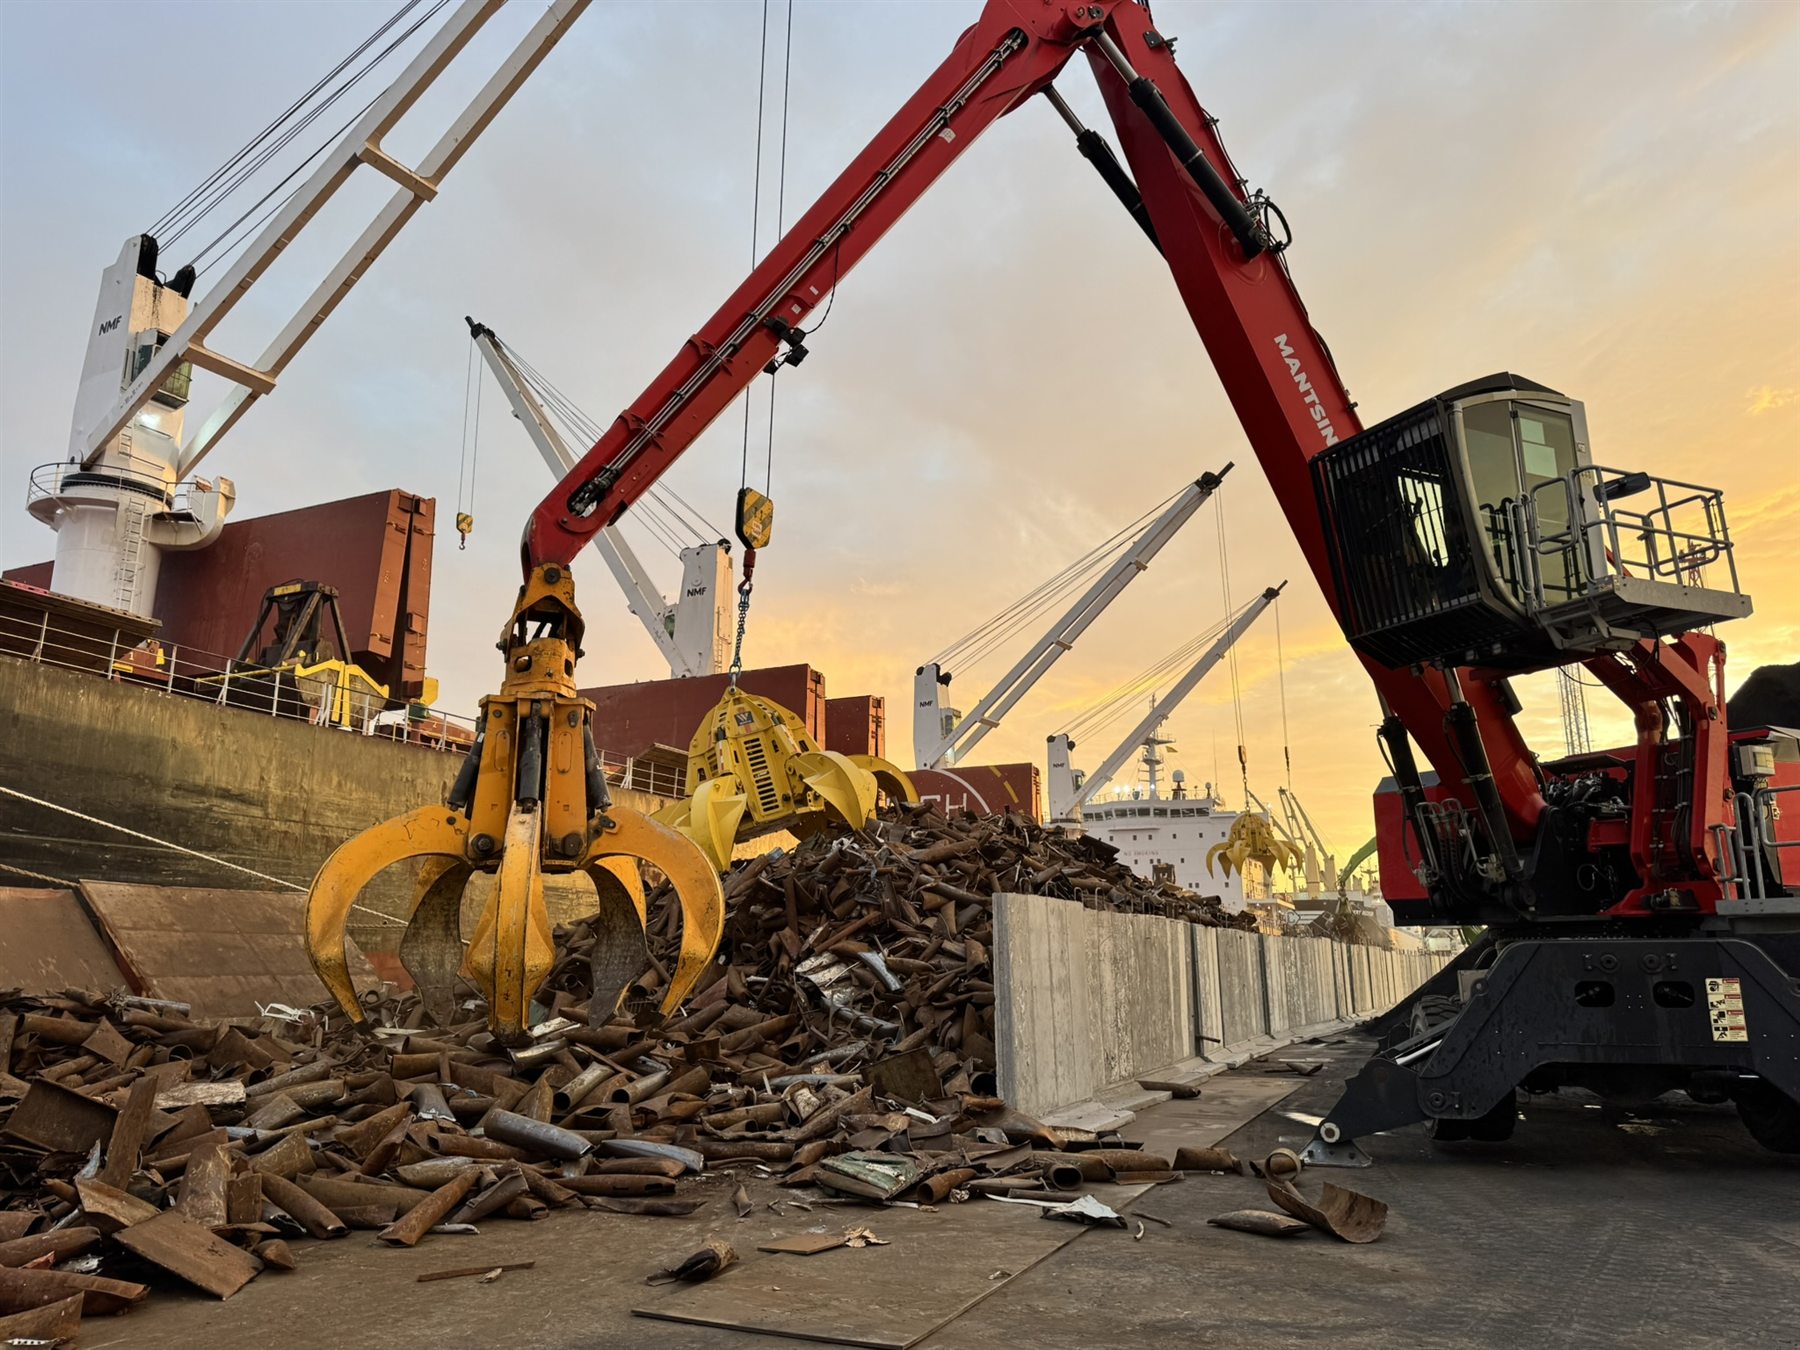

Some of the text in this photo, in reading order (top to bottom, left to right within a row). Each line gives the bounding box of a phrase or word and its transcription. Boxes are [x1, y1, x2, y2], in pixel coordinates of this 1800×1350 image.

[98, 315, 122, 336] NMF
[687, 586, 707, 597] NMF
[919, 699, 934, 708] NMF
